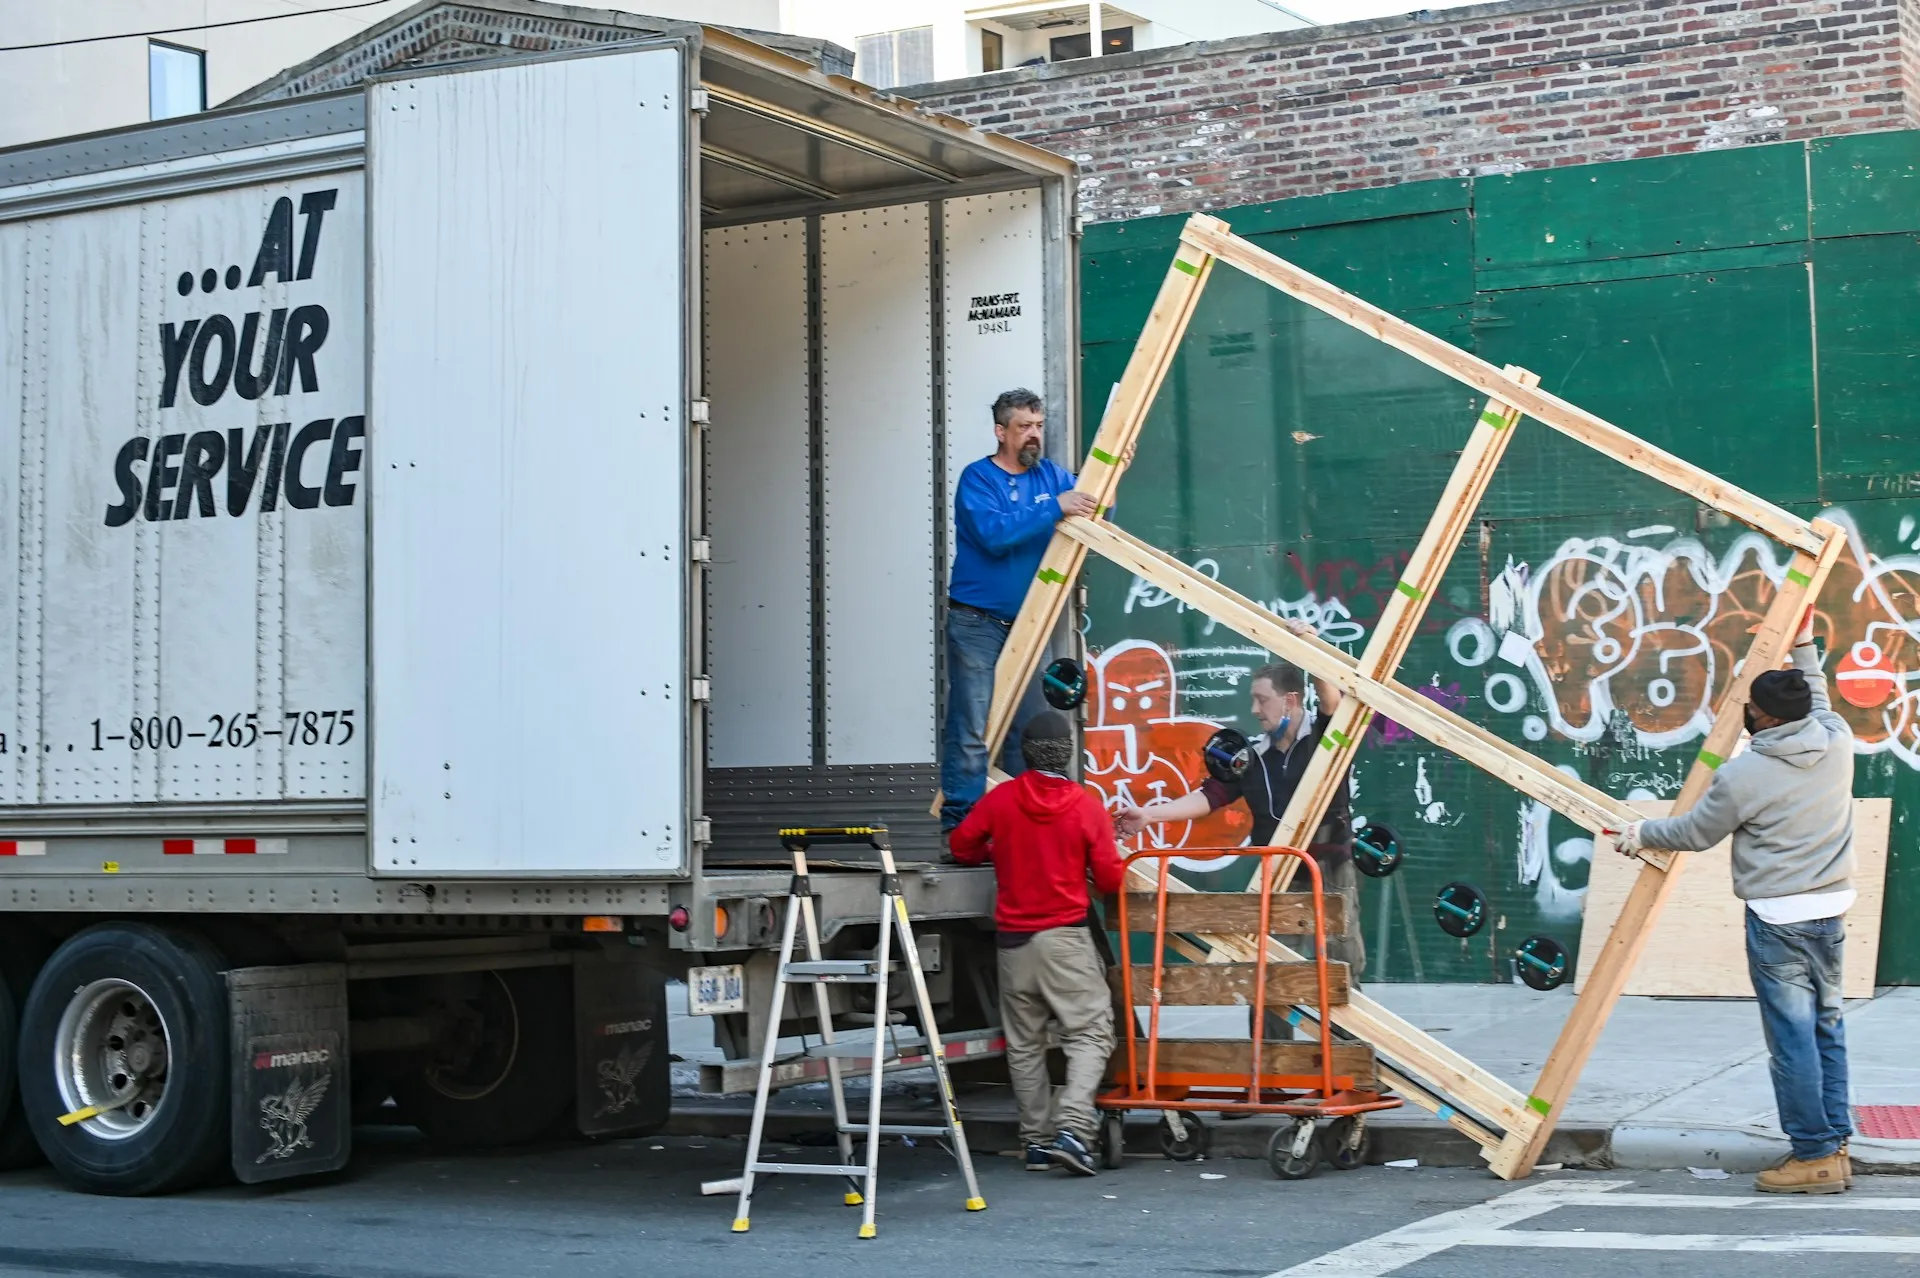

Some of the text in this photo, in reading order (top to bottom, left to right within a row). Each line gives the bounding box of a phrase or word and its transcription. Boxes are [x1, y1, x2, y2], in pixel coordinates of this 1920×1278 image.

[158, 304, 330, 409] YOUR
[104, 415, 365, 527] SERVICE
[91, 709, 355, 751] 1-800-265-7875
[605, 1018, 652, 1036] manac
[270, 1049, 329, 1068] manac
